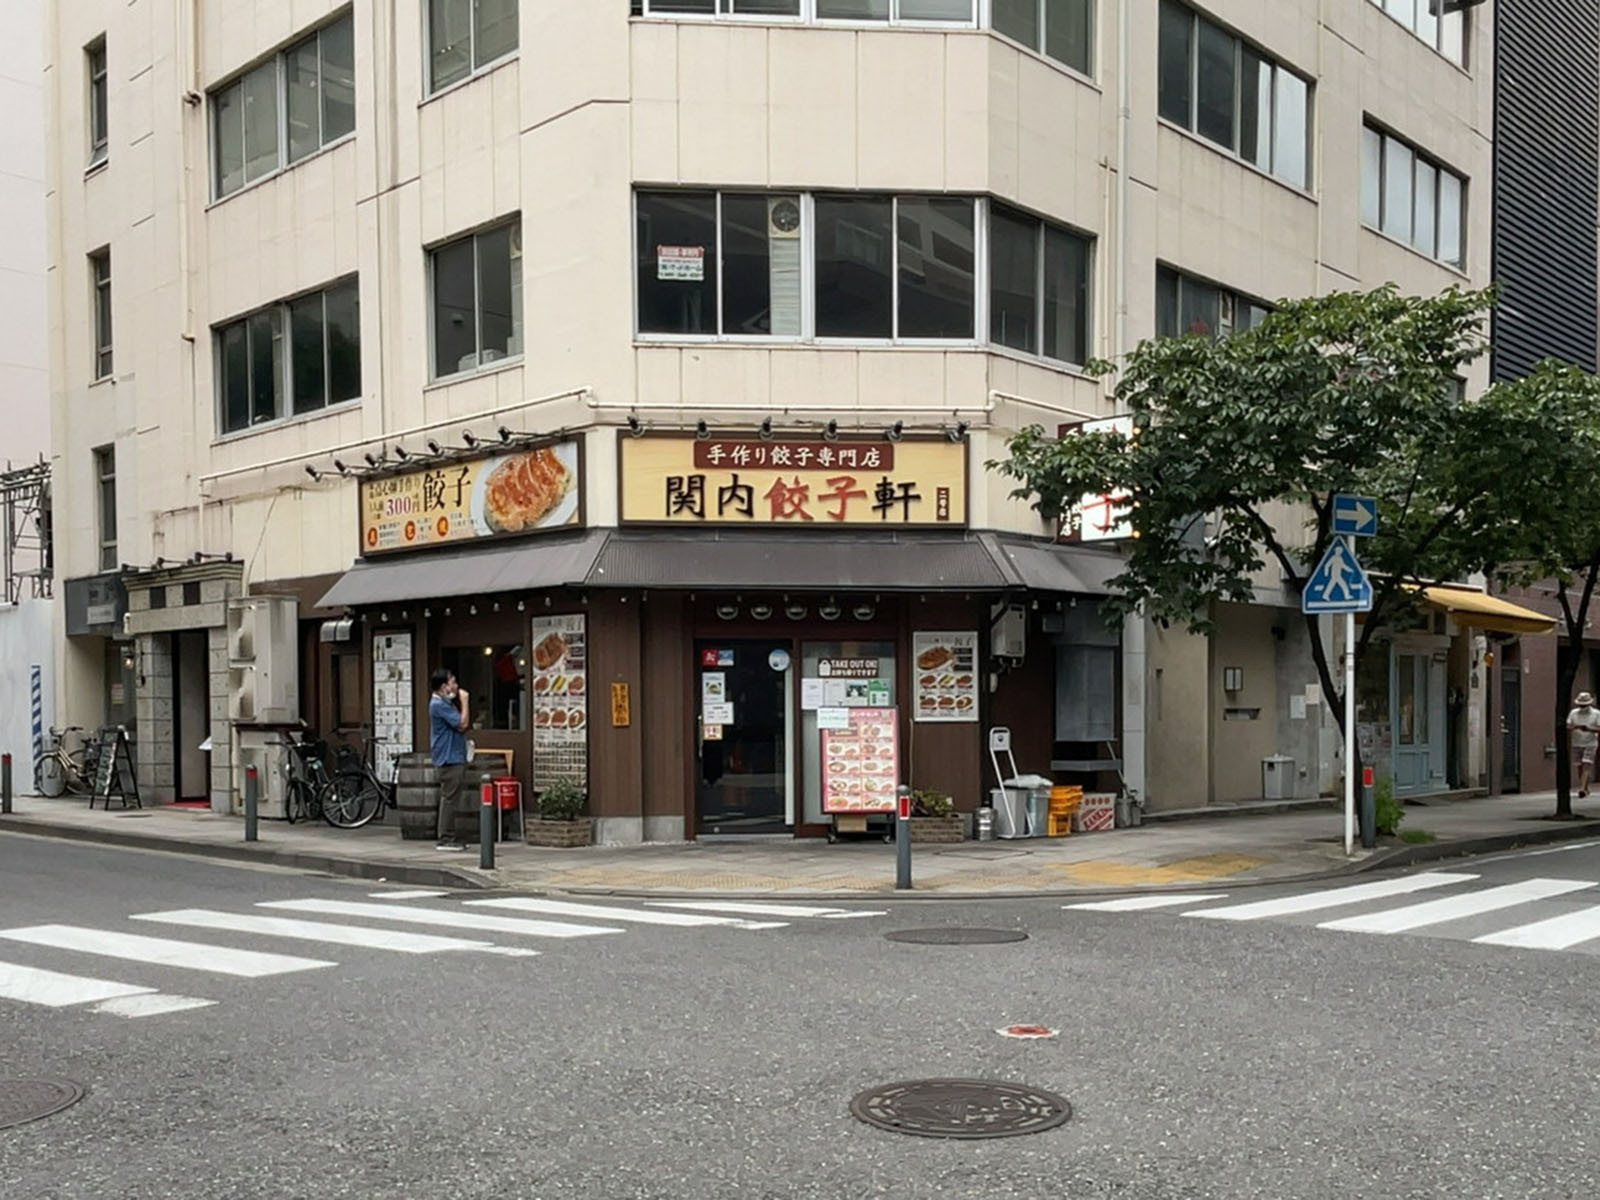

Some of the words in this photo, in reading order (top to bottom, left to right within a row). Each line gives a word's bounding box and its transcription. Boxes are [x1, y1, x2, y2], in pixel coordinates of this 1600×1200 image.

[706, 444, 881, 468] 手作り餃子専門店
[423, 466, 471, 512] 餃子
[666, 473, 922, 522] 関内餃子軒
[831, 660, 849, 668] TAKE
[849, 660, 864, 668] OUT
